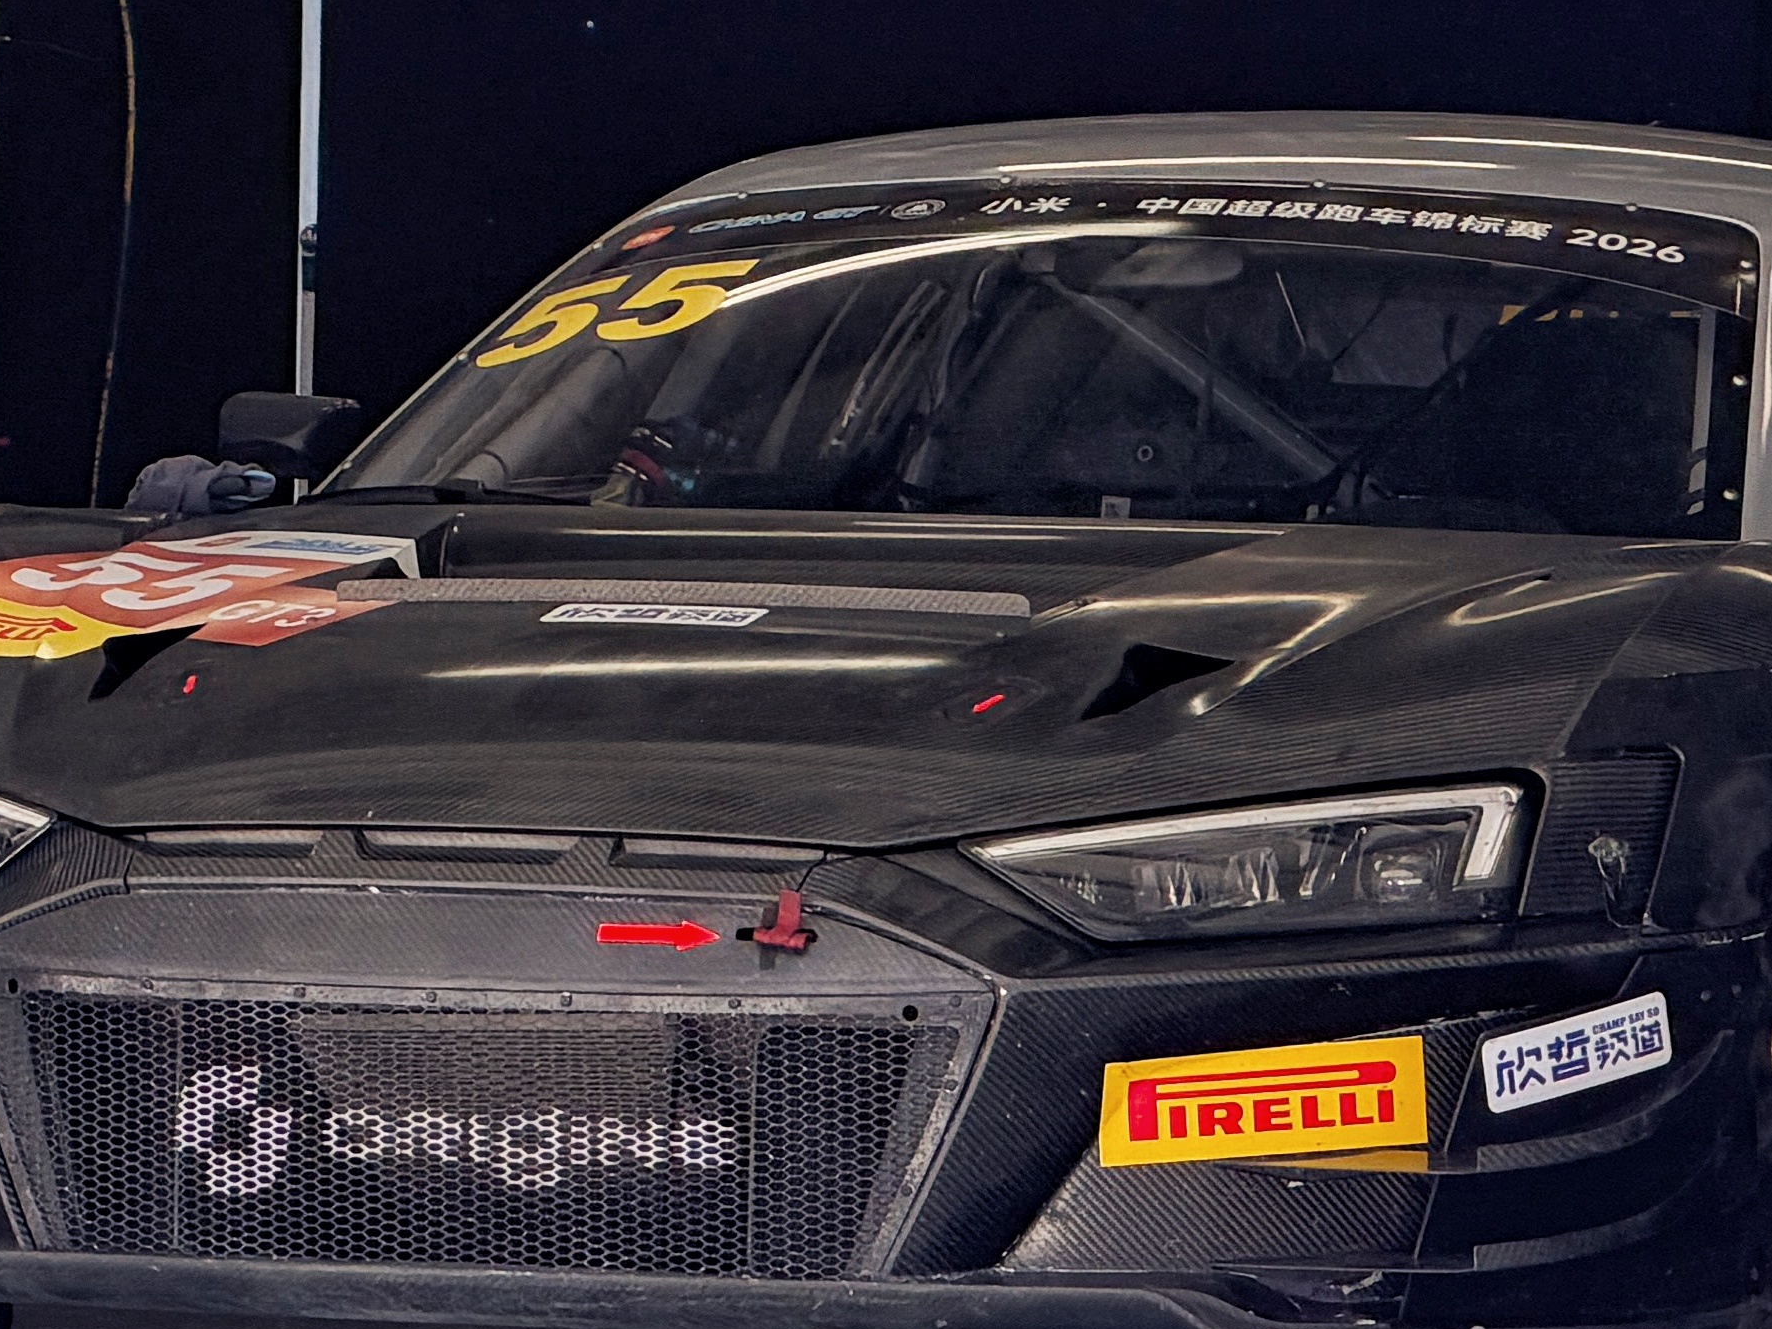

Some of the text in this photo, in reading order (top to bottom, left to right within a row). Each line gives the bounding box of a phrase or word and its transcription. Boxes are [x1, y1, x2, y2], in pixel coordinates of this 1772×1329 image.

[979, 194, 1686, 264] 小米 中国超级跑车锦标赛 2026
[476, 259, 760, 368] 55
[11, 552, 295, 610] 55
[209, 599, 337, 628] GT3
[1496, 1020, 1664, 1097] 欣哲频道
[1592, 1016, 1627, 1035] CHAMP
[1128, 1060, 1396, 1141] PIRELLI
